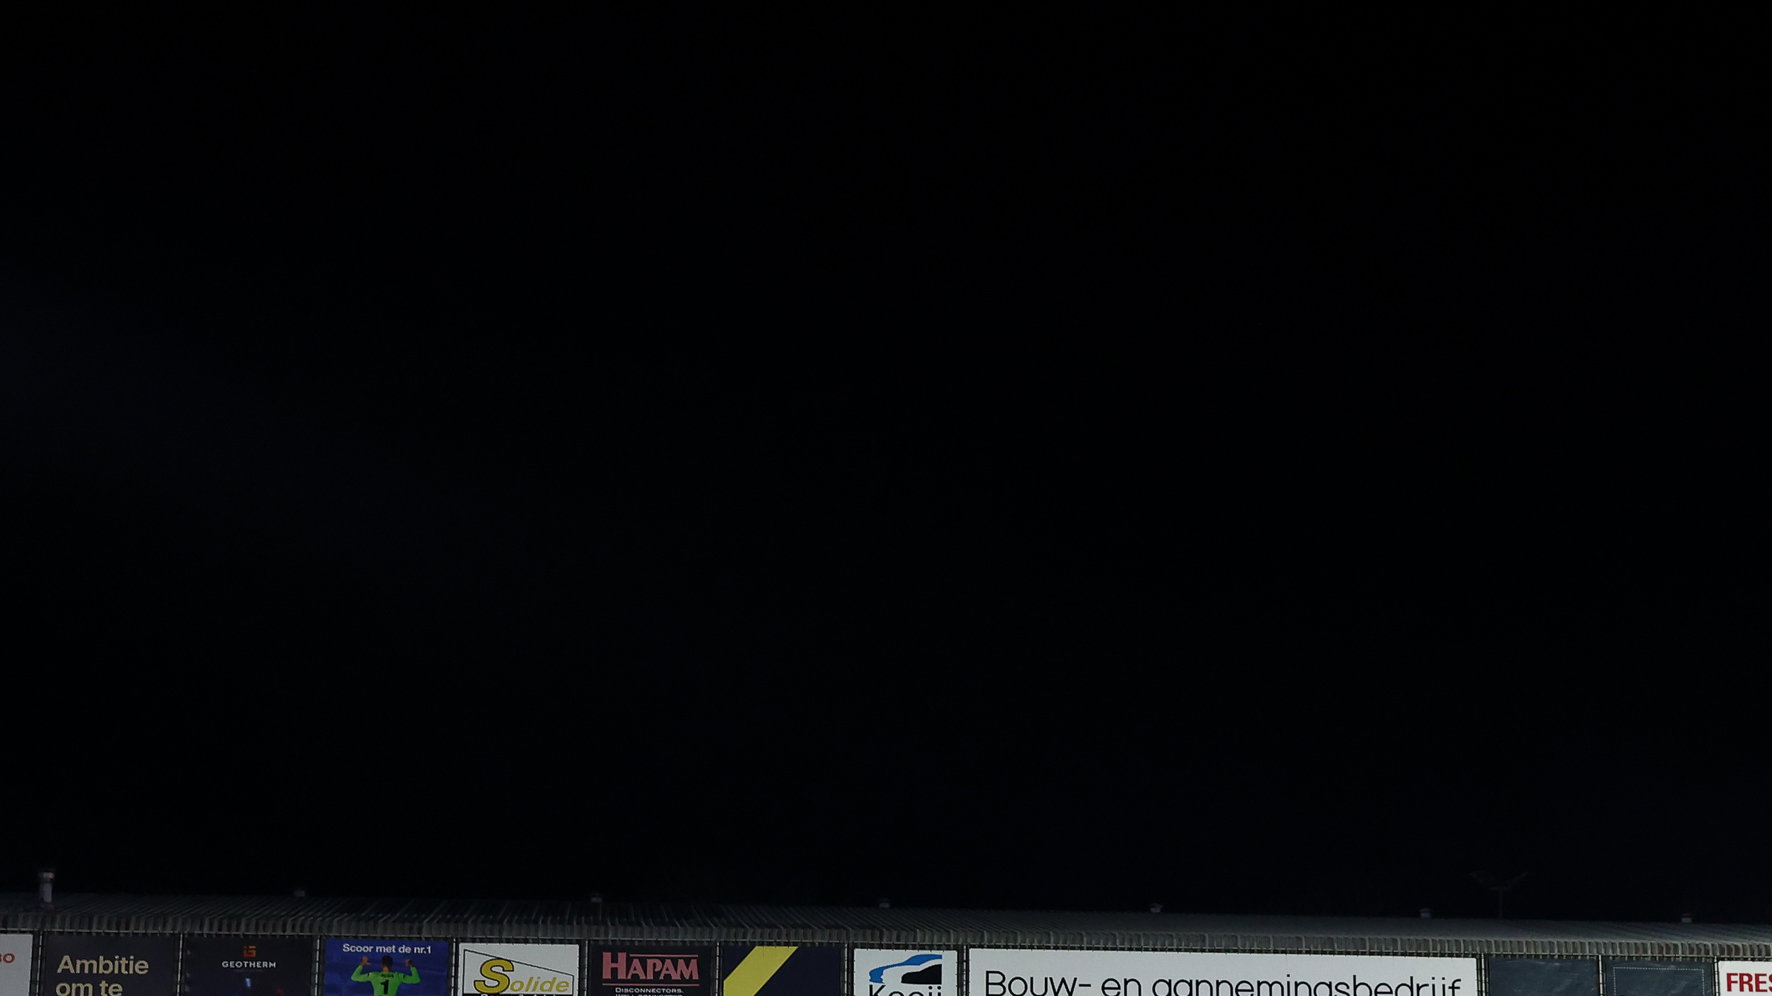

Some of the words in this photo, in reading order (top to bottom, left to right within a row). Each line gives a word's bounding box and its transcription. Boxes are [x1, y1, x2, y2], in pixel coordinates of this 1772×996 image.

[342, 944, 374, 952] Scoor
[376, 944, 396, 953] met
[398, 944, 412, 954] de
[414, 946, 432, 954] nr.1
[57, 955, 149, 975] Ambitie
[602, 952, 700, 980] HAPAM
[473, 958, 570, 994] Solide
[55, 982, 93, 996] om
[380, 980, 390, 995] 1
